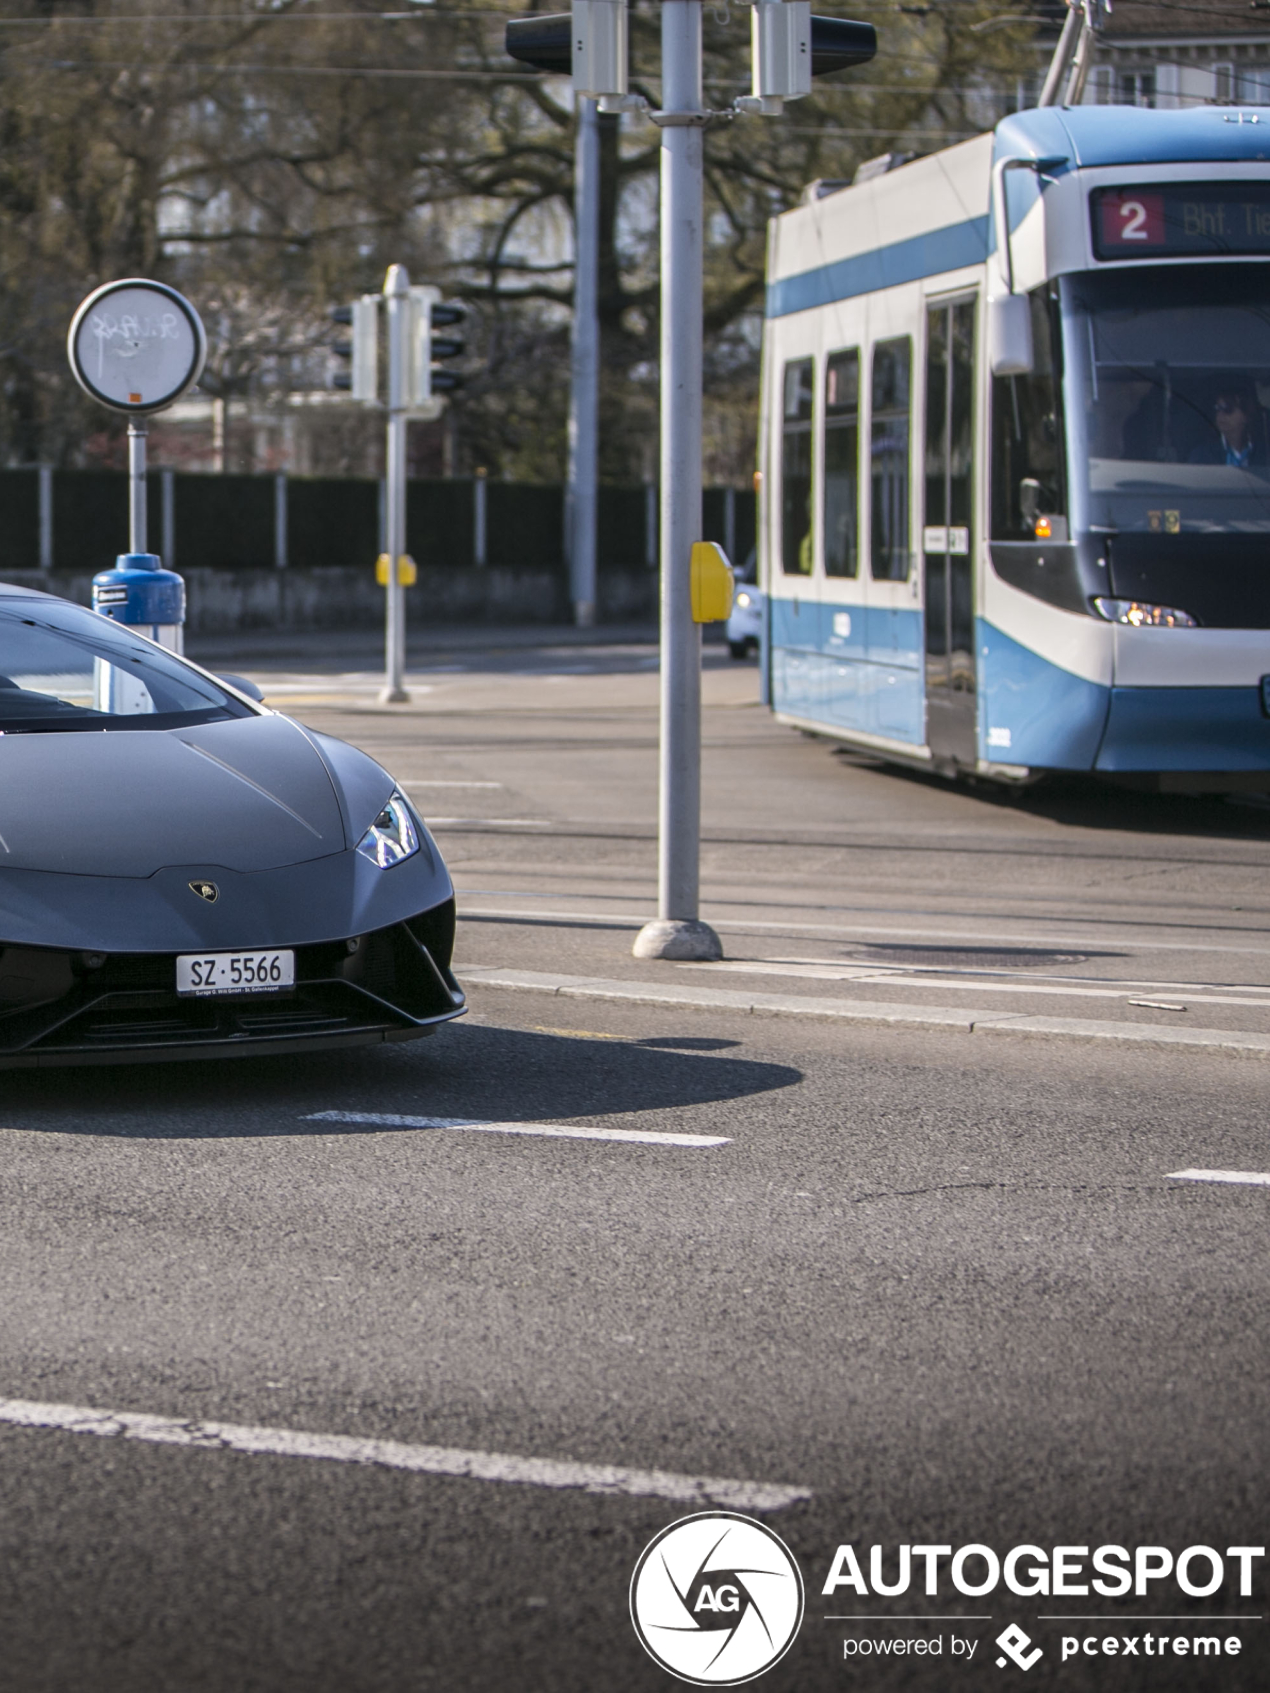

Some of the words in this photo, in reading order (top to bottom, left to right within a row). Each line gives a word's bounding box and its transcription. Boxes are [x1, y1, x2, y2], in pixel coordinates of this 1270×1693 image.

[1120, 201, 1148, 240] 2
[1183, 202, 1232, 236] Bhf.
[191, 960, 216, 986] SZ
[230, 956, 281, 983] 5566
